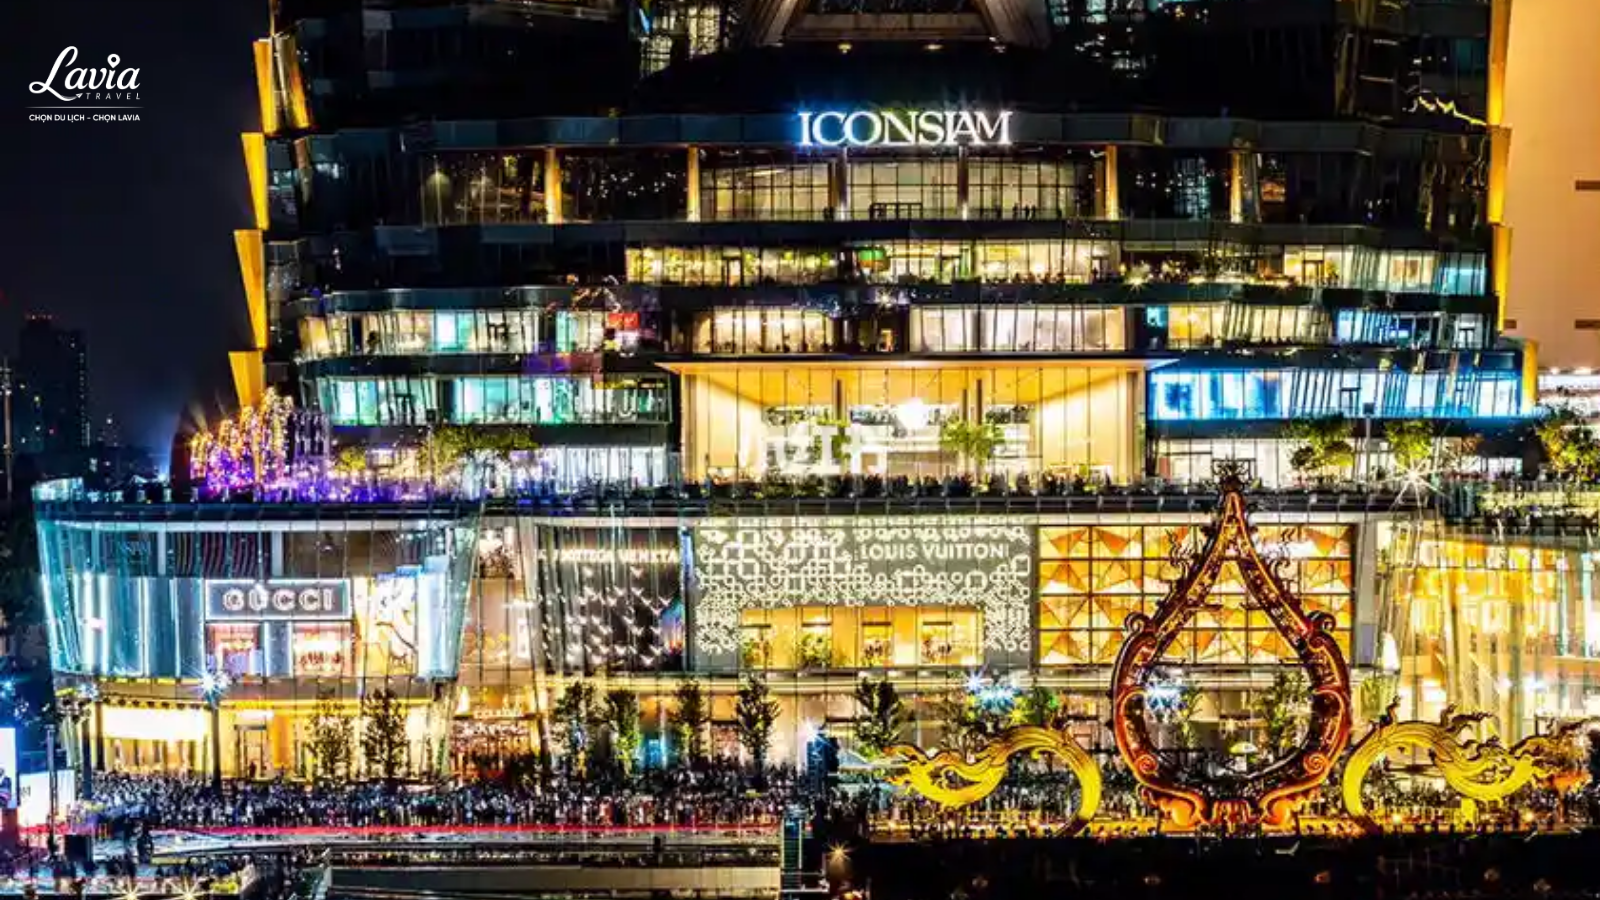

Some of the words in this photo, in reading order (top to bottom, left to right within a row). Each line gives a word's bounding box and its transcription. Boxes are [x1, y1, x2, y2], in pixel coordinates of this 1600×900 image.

[797, 110, 1014, 147] ICONSIAM
[860, 543, 918, 560] LOUIS
[921, 543, 1003, 560] VUITTON
[222, 587, 334, 612] GUCCI
